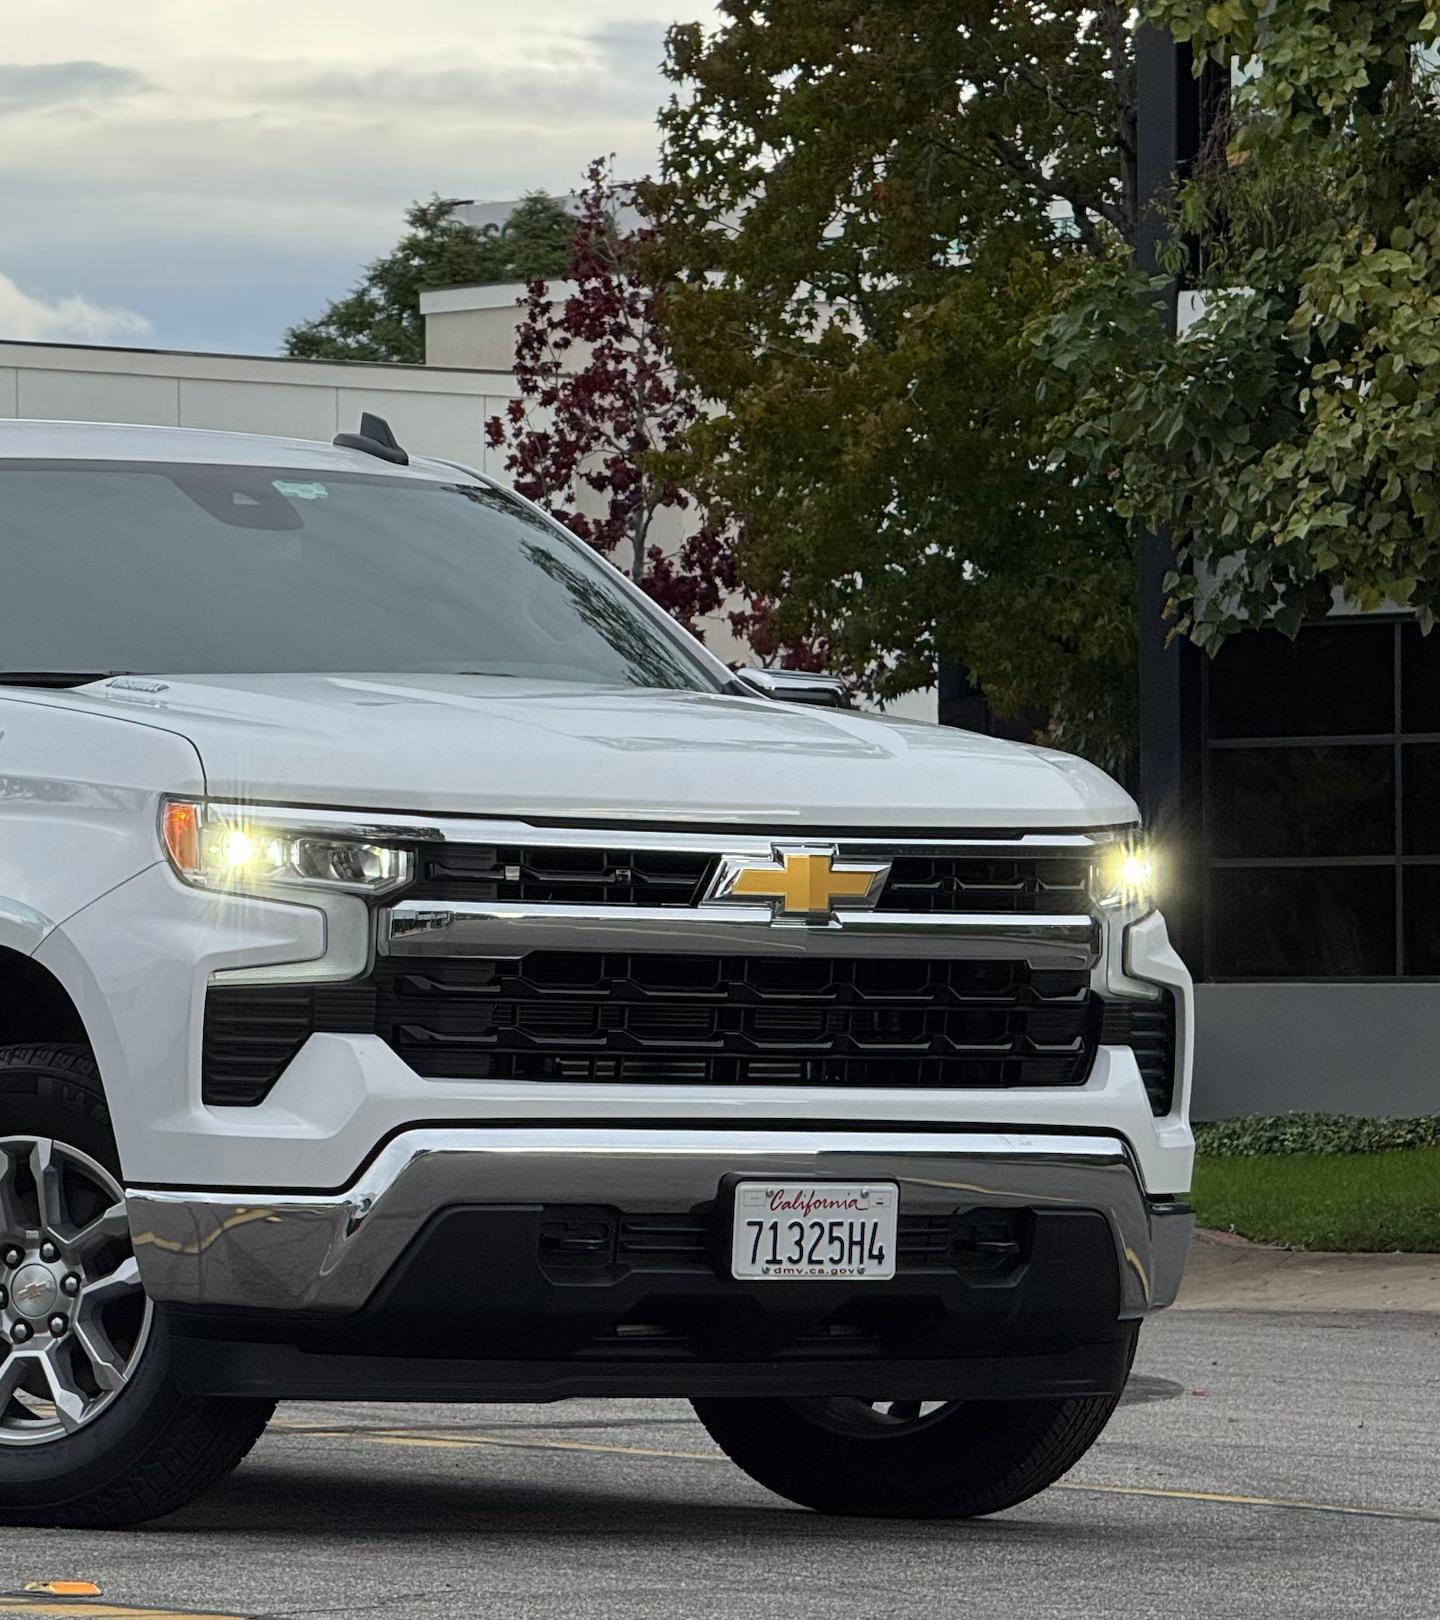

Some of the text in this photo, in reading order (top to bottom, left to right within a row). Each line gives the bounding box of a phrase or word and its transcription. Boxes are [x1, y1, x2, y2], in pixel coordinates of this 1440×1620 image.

[770, 1189, 869, 1217] California
[746, 1220, 886, 1265] 71325H4
[773, 1266, 856, 1276] dmv.ca.gov
